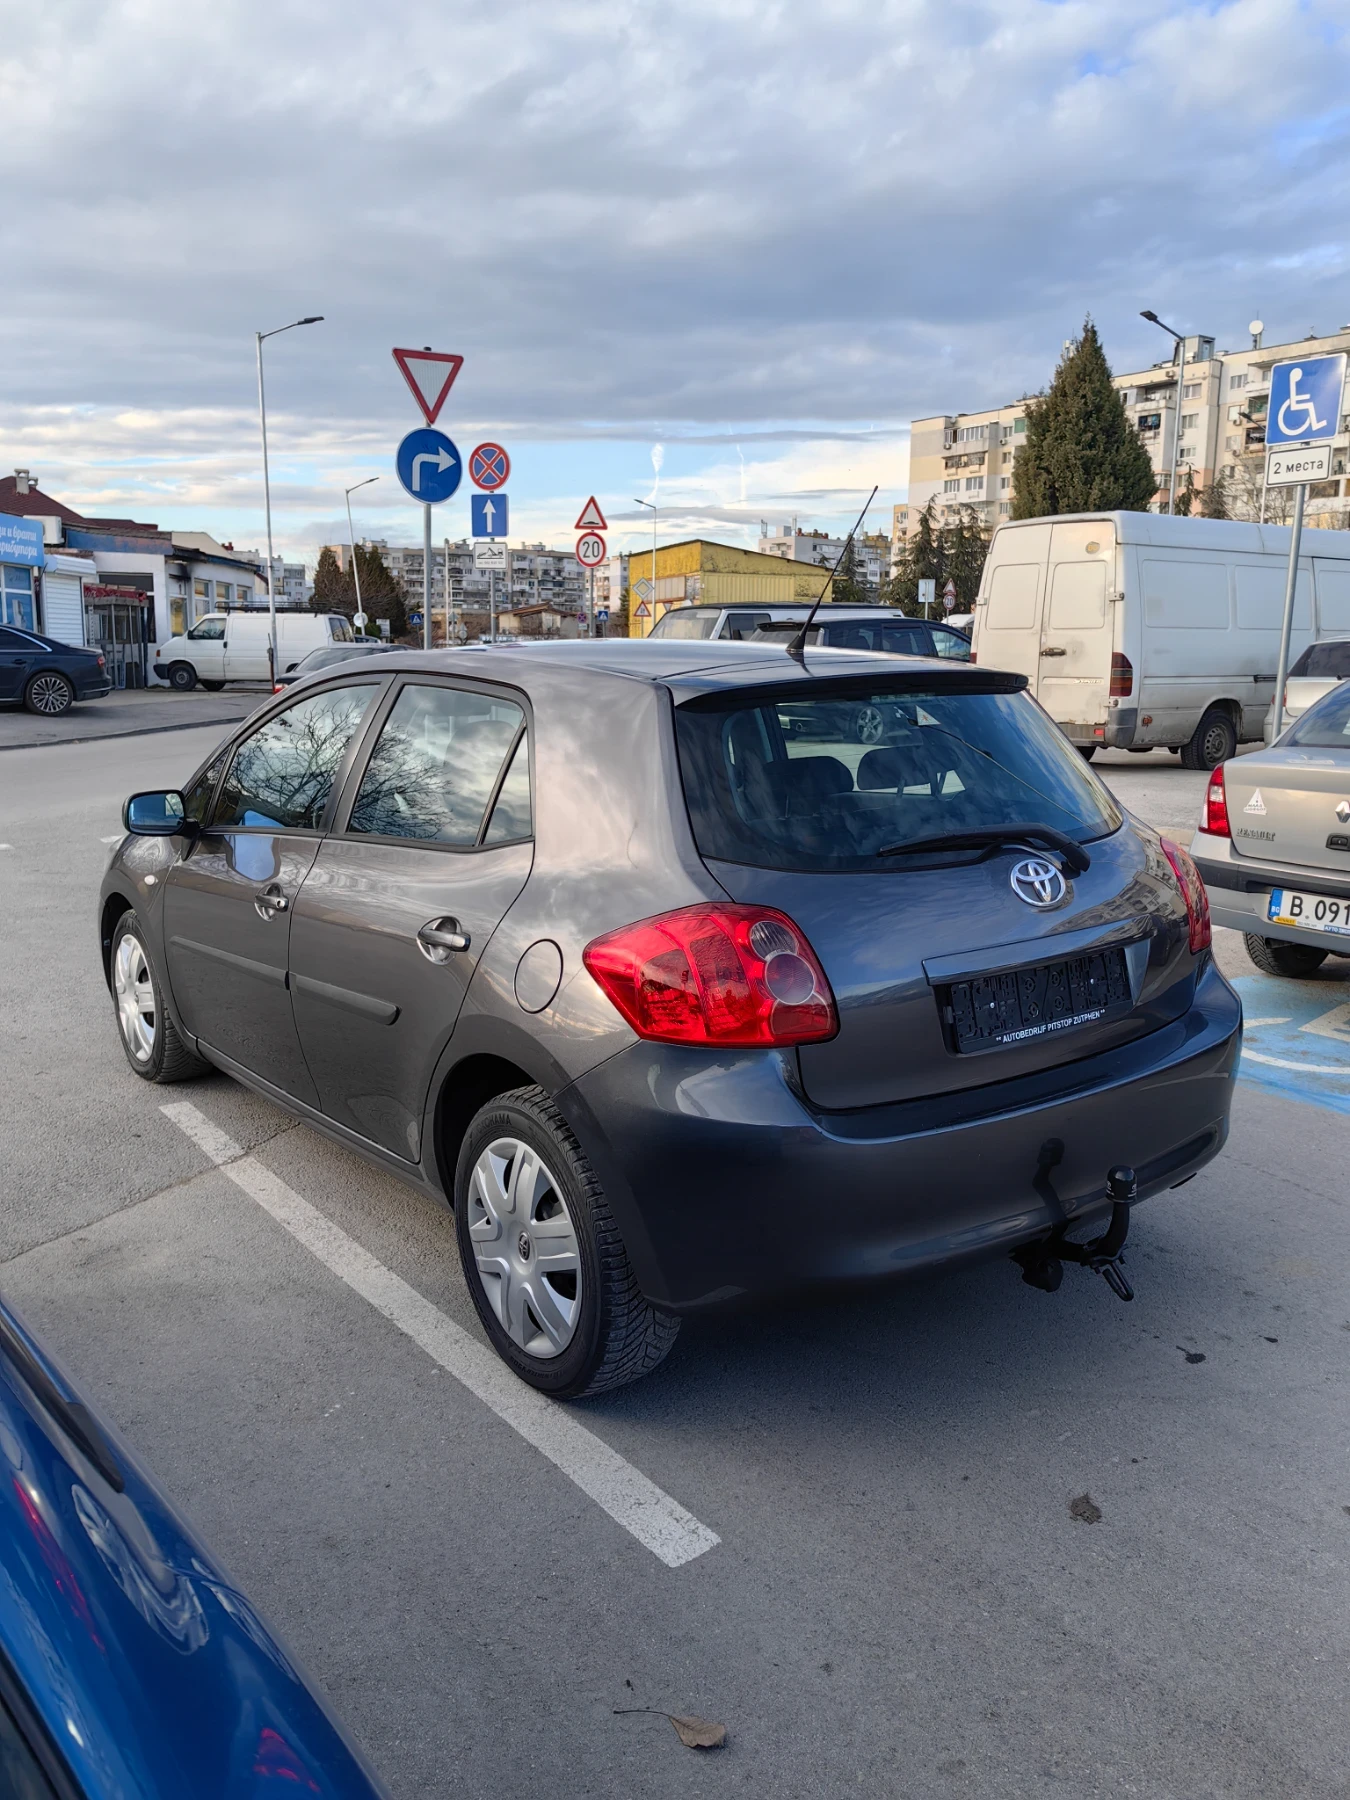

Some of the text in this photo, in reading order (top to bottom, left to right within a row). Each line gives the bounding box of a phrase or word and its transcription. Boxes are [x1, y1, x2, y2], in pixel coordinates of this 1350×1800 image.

[1273, 460, 1324, 475] 2 места
[0, 541, 38, 559] рибутори
[582, 540, 600, 558] 20
[1271, 905, 1280, 913] BG
[1290, 895, 1303, 917] B
[1002, 1010, 1100, 1043] AUTOBEDRIJF PITSTOP ZUTPHEN
